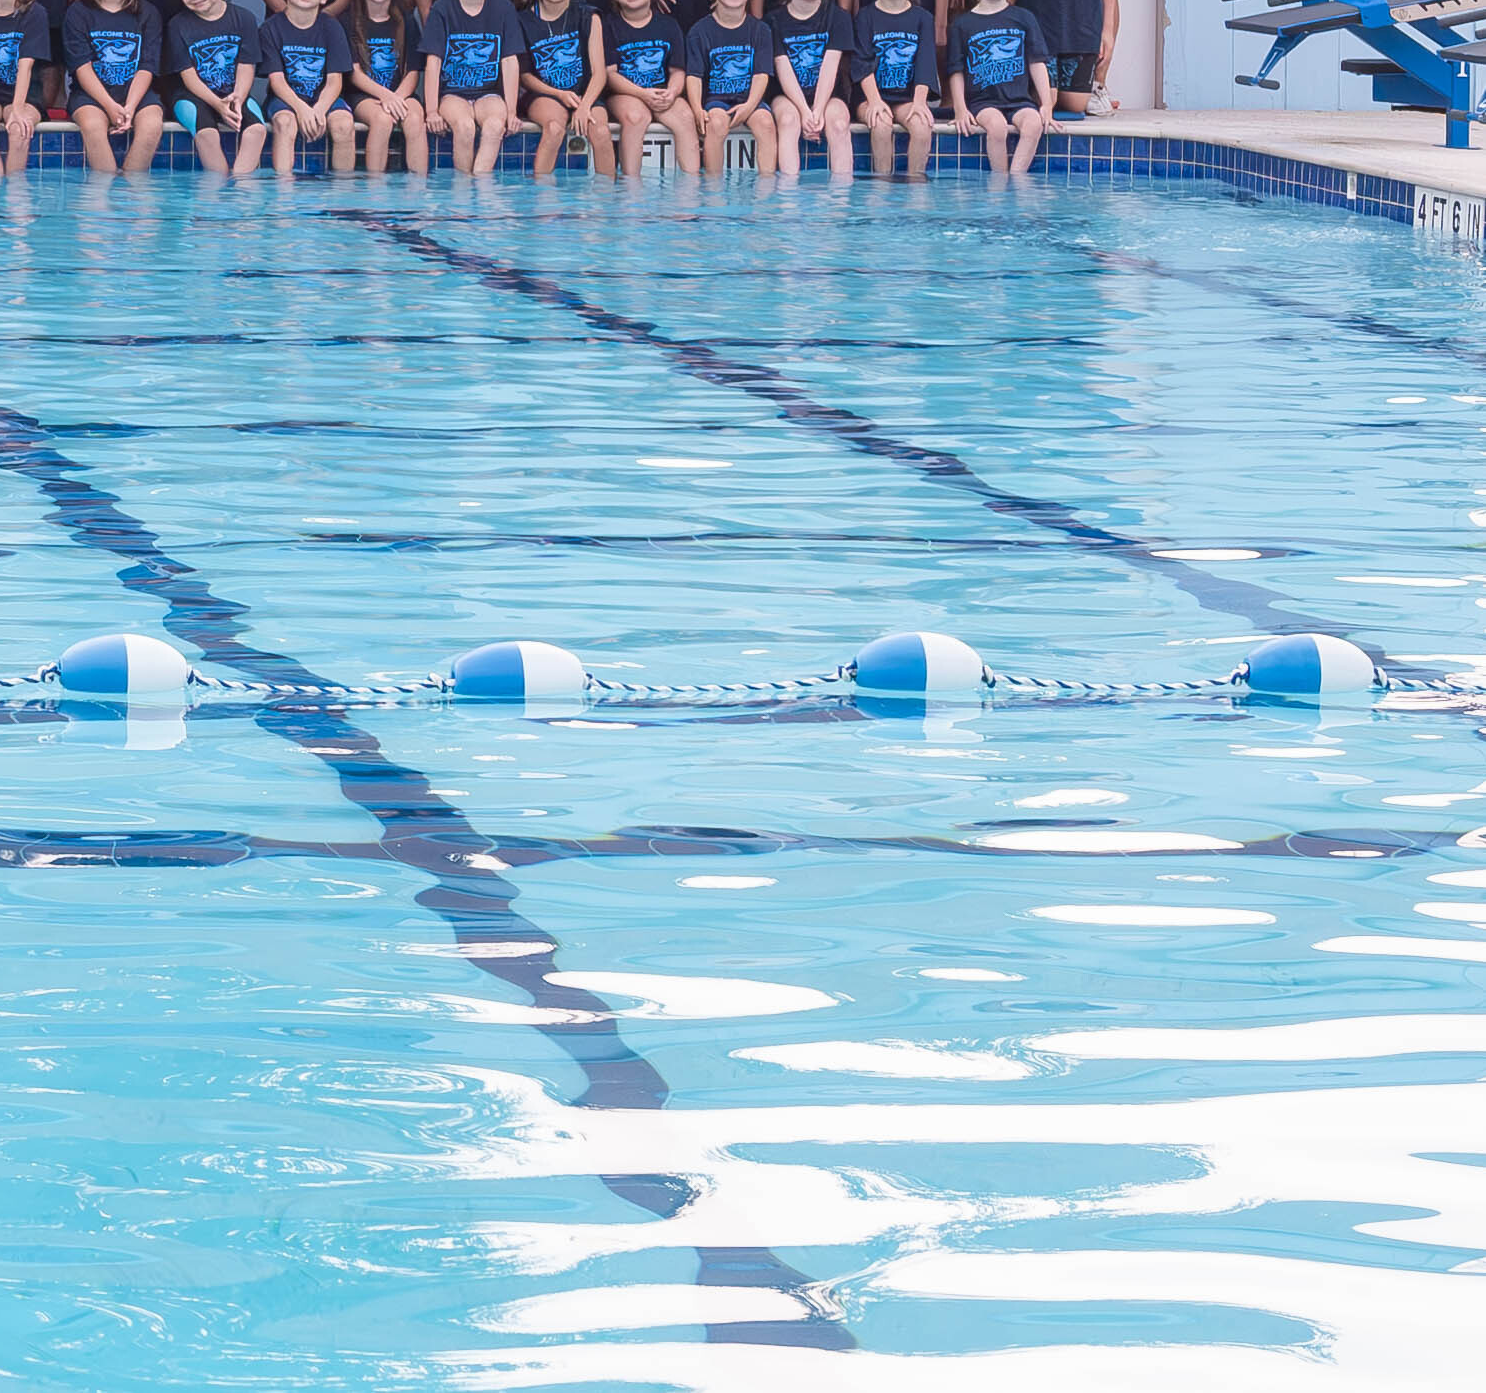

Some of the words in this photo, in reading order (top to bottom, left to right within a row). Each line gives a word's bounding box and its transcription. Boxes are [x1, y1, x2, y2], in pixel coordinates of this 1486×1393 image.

[727, 140, 755, 169] IN
[1418, 193, 1426, 228] 4
[1432, 196, 1447, 231] FT
[1452, 200, 1461, 233] 6
[1467, 203, 1481, 239] IN
